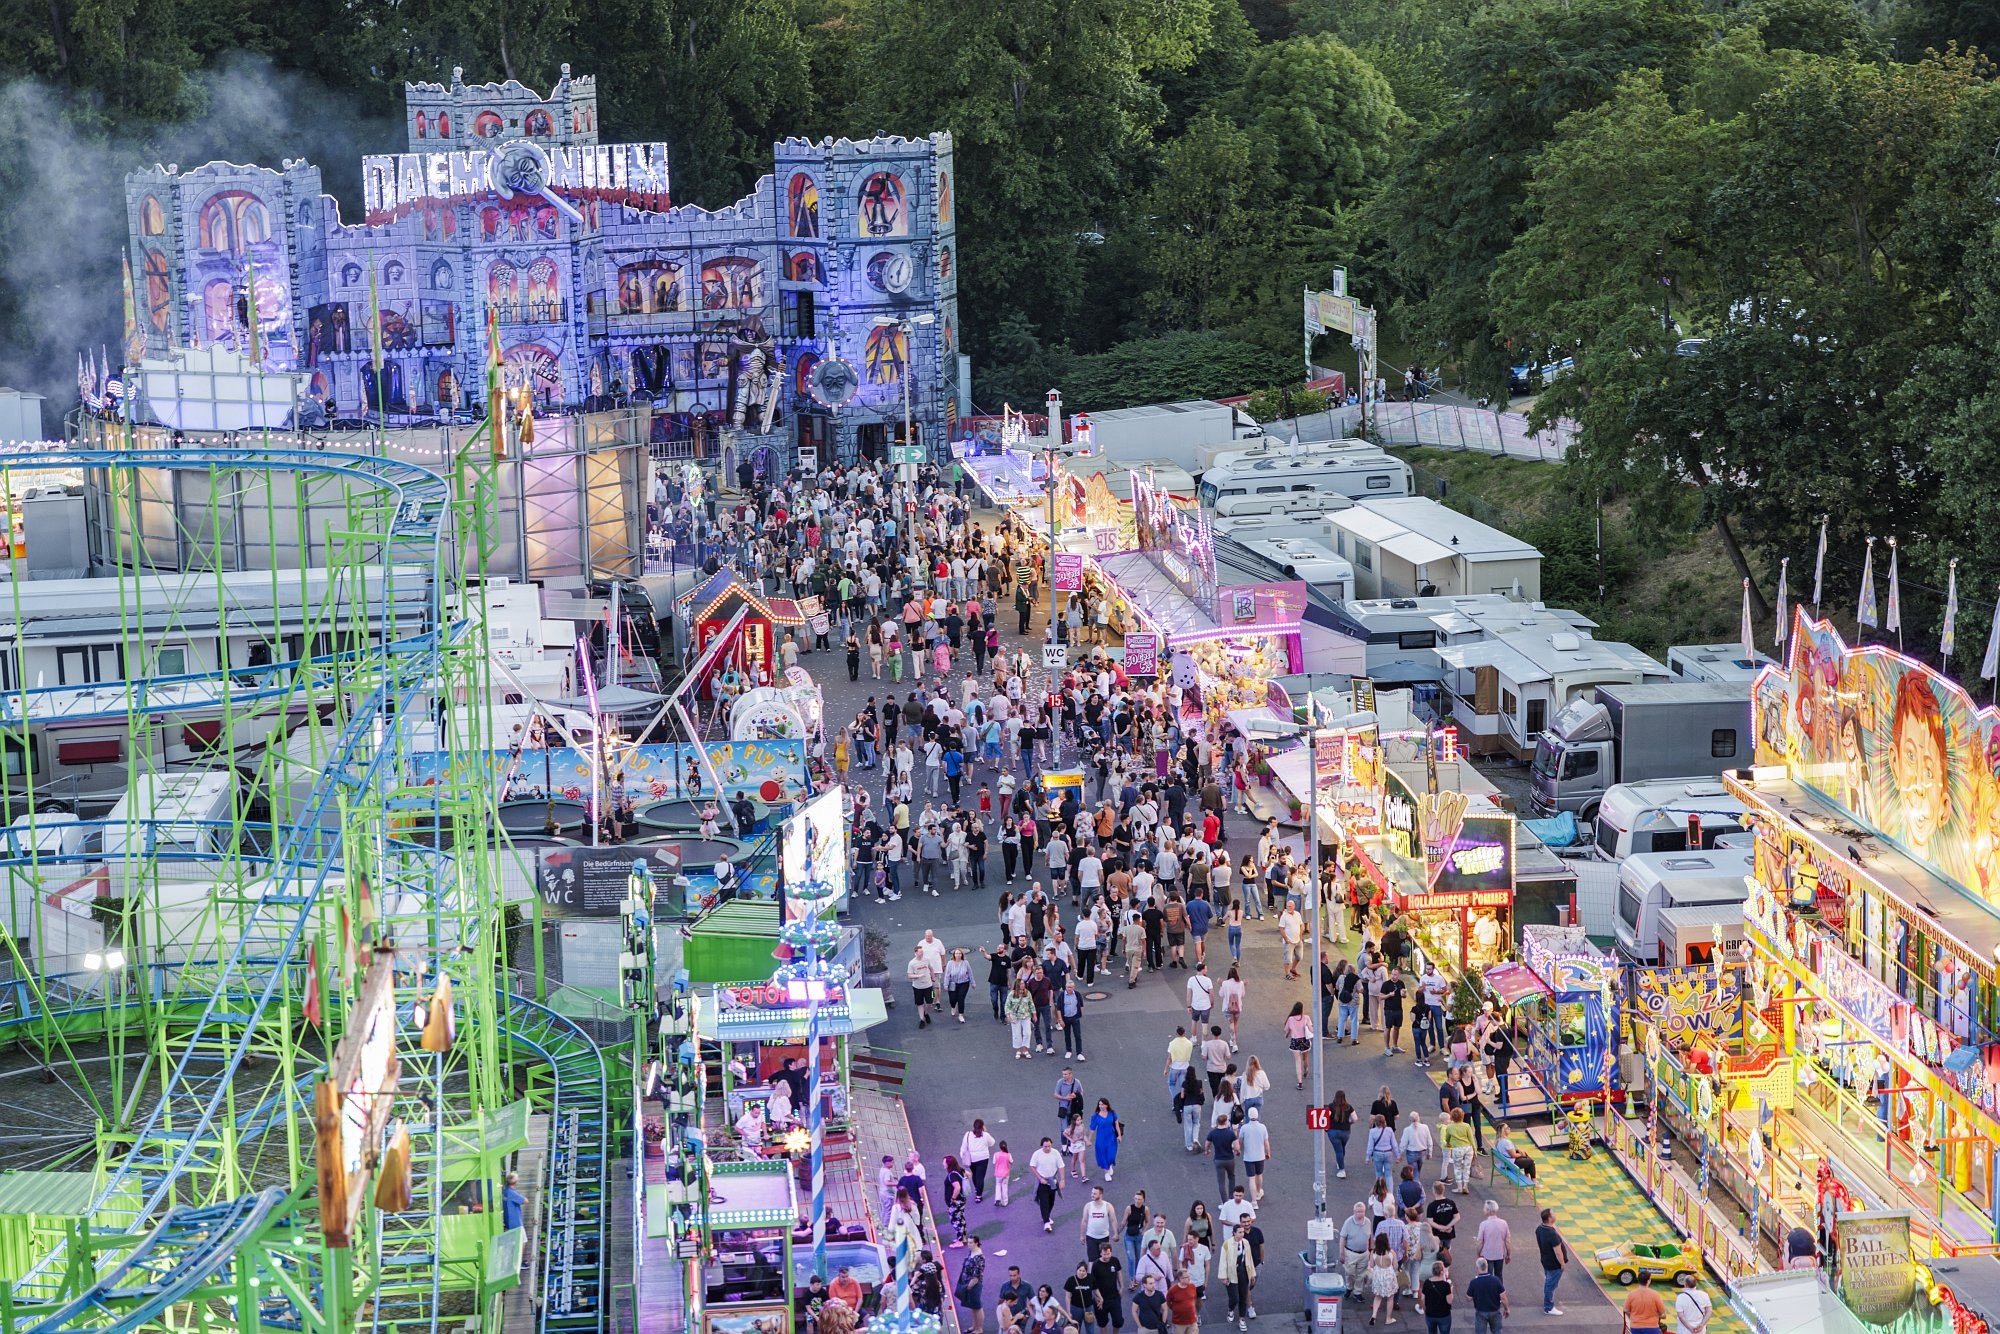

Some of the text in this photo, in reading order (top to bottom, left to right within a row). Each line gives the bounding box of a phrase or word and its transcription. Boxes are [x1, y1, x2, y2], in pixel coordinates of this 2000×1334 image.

[362, 140, 669, 214] DAEMONIUM
[906, 503, 916, 512] 14
[1095, 531, 1117, 551] EIS
[1045, 649, 1065, 657] WC
[1126, 653, 1138, 668] 50
[1050, 695, 1062, 706] 15
[743, 743, 775, 767] FLY
[1472, 890, 1509, 906] POMMES
[1651, 1009, 1734, 1032] TOWN
[1310, 1109, 1328, 1128] 16
[1846, 1237, 1891, 1254] BALL-
[1846, 1252, 1909, 1269] WERFEN
